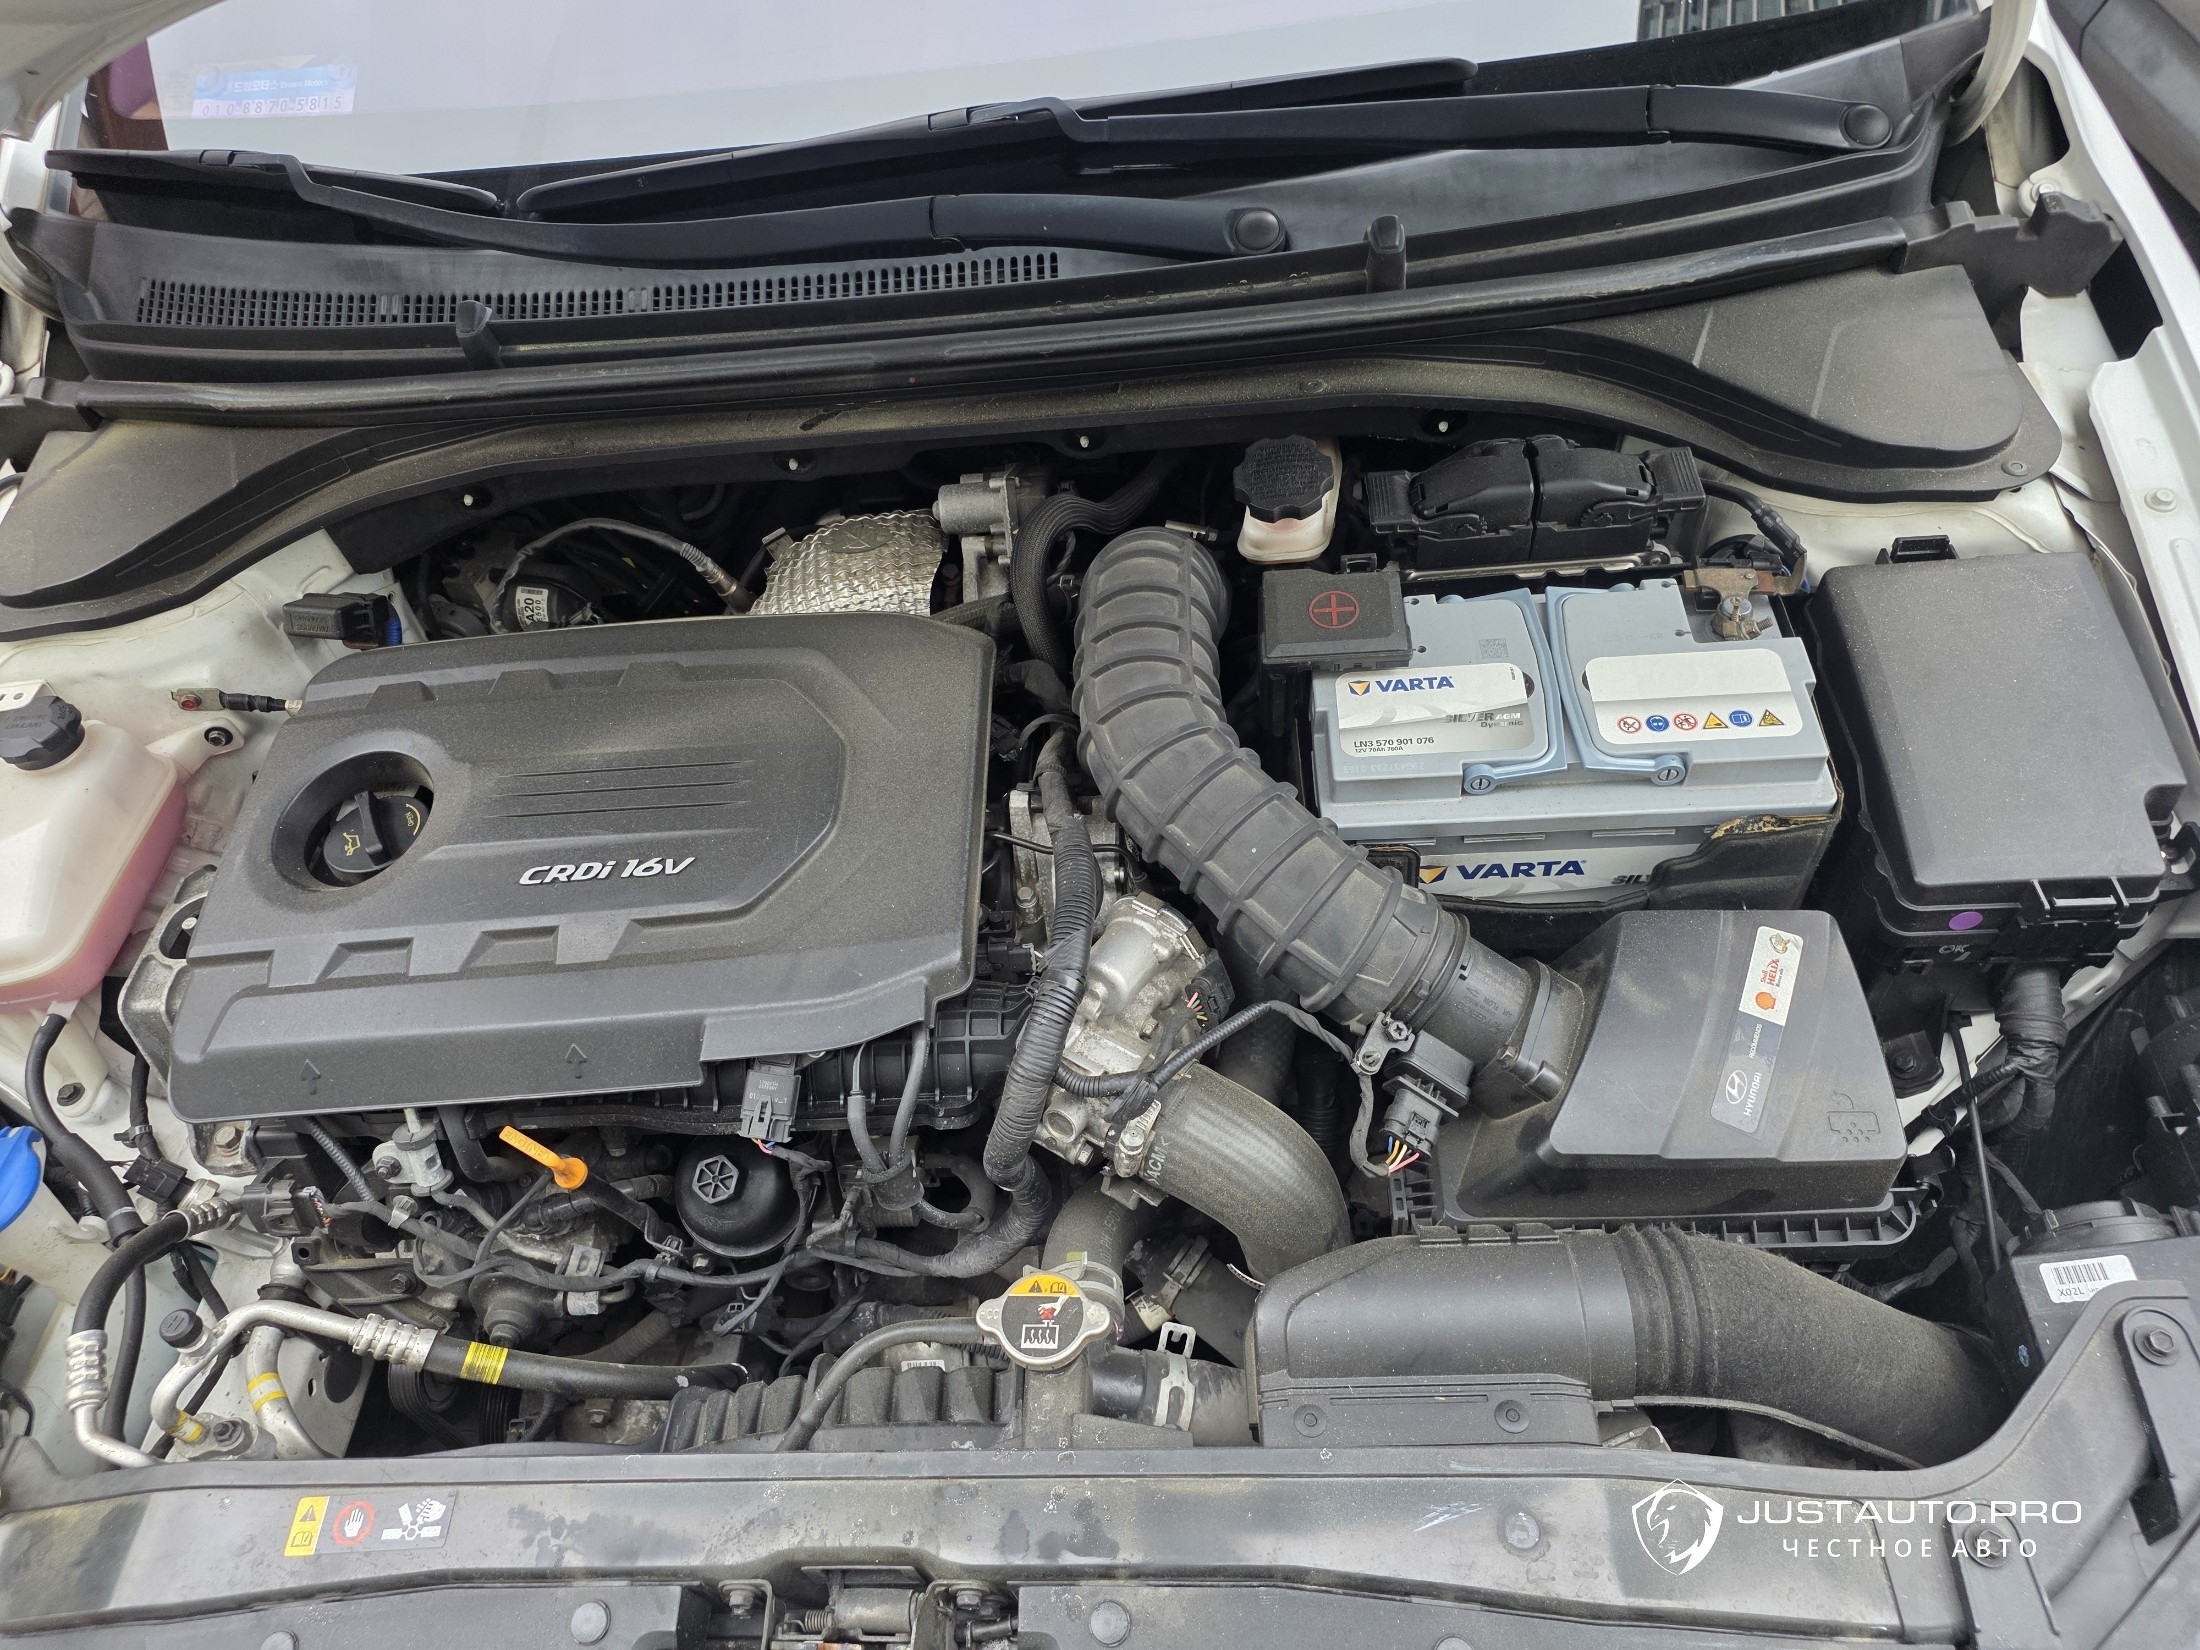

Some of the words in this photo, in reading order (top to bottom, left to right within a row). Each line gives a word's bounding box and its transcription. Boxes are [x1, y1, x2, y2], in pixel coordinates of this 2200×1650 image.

[202, 96, 343, 117] 010-8870-5815
[1375, 676, 1455, 693] VARTA
[1495, 712, 1521, 720] AGM
[1354, 739, 1374, 748] LN3
[1376, 738, 1394, 747] 570
[1397, 738, 1414, 746] 901
[1416, 736, 1435, 745] 076
[519, 860, 617, 885] CRDi
[620, 856, 696, 878] 16V
[1456, 860, 1585, 879] VARTA
[1766, 959, 1780, 986] HELIX
[1743, 1071, 1762, 1117] HYUNDAI
[2057, 1286, 2085, 1297] X02L
